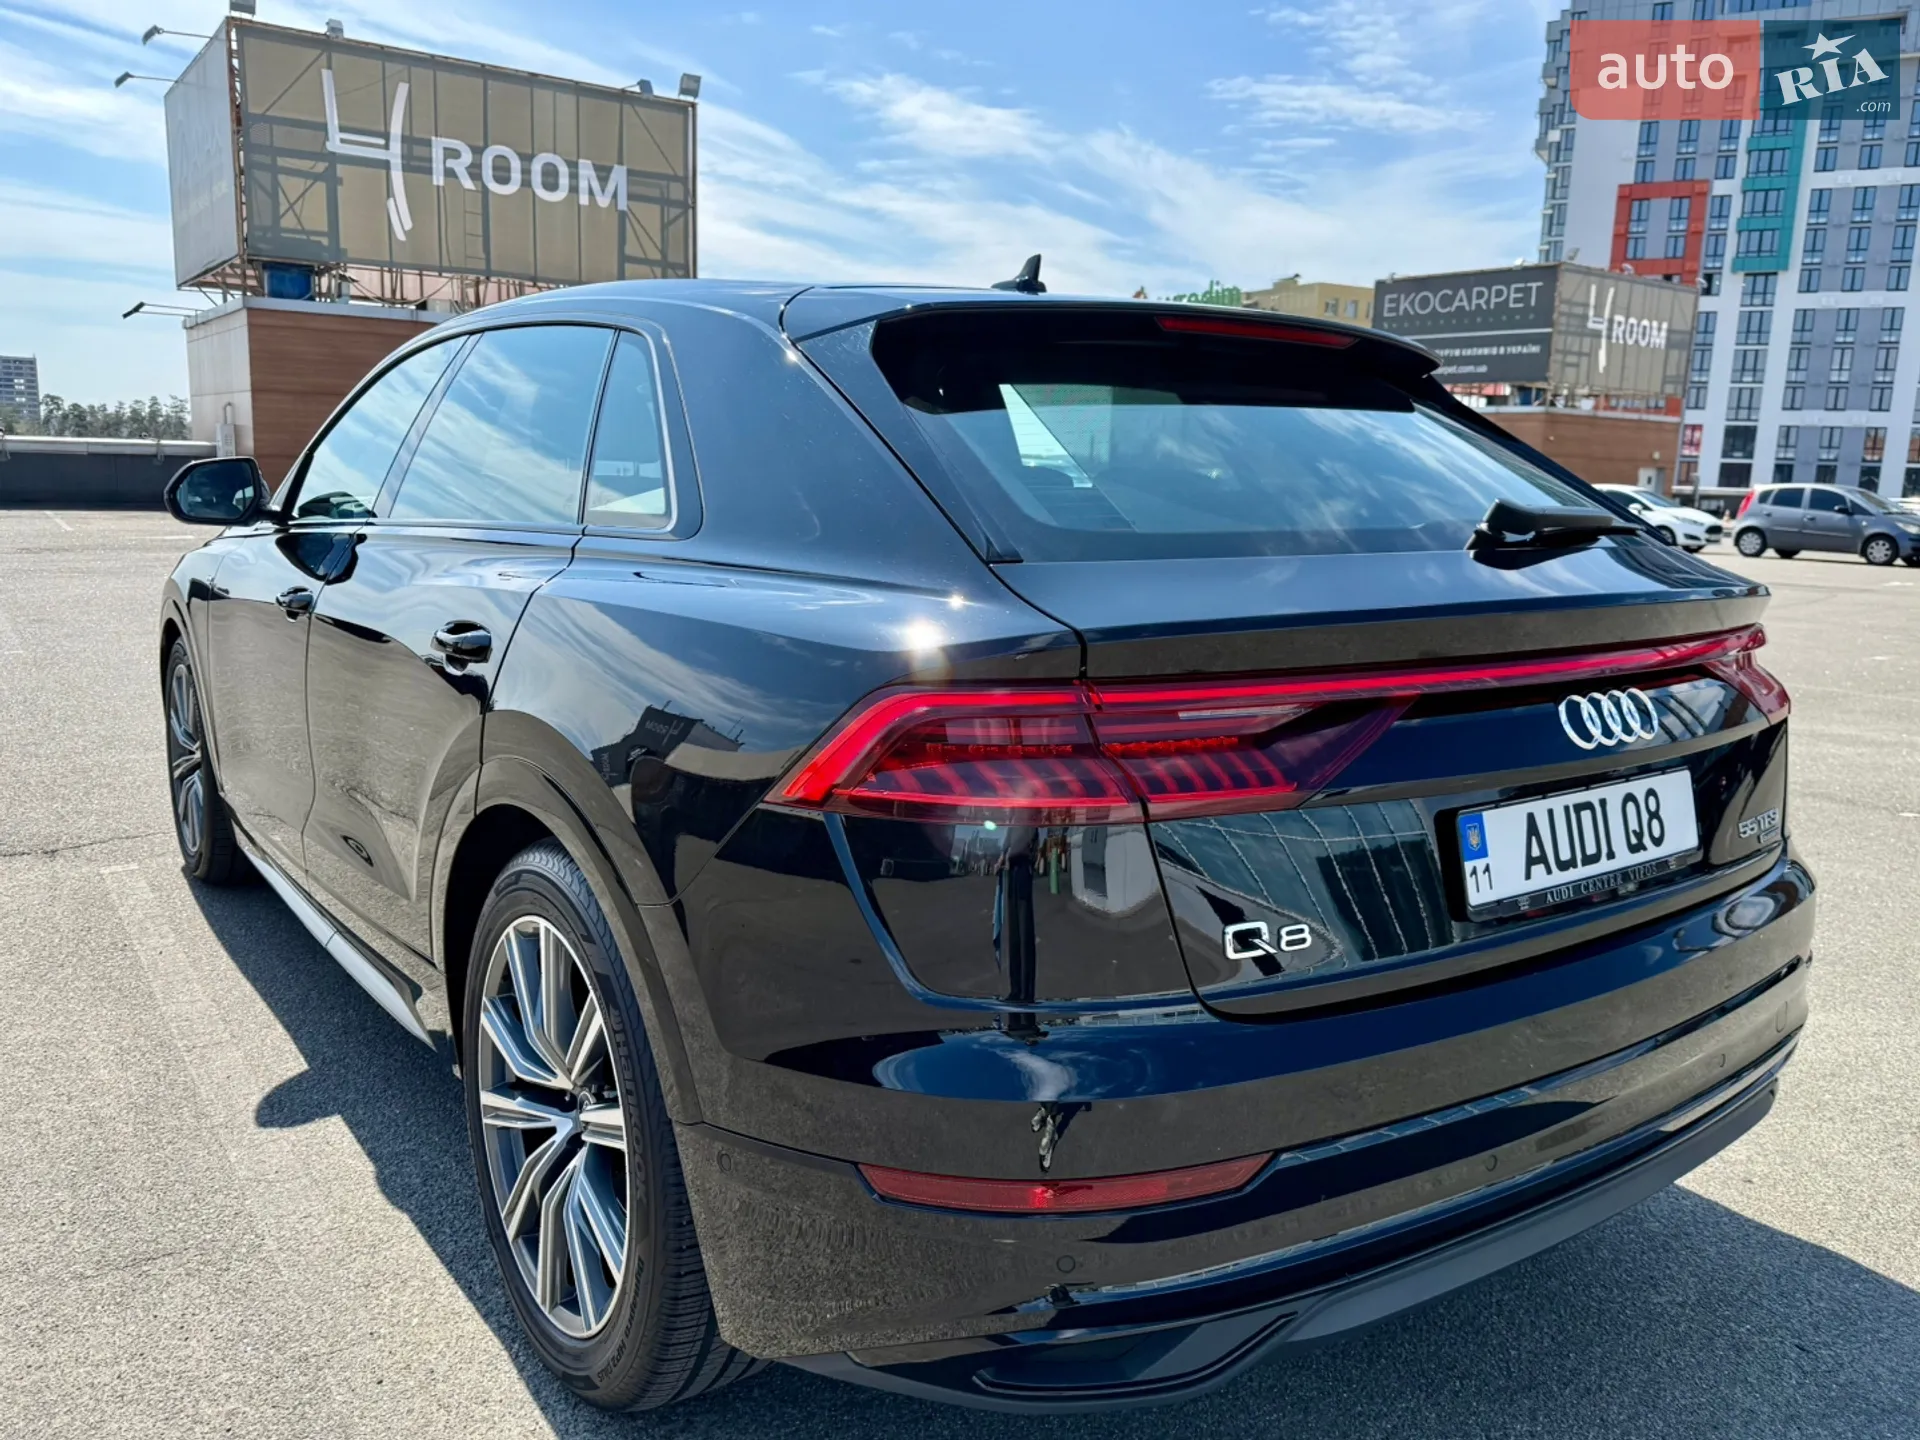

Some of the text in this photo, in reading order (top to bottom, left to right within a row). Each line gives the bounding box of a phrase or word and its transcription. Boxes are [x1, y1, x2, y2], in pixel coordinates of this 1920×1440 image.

[431, 136, 628, 211] ROOM
[1383, 281, 1544, 317] EKOCARPET
[1612, 314, 1668, 349] ROOM
[1525, 788, 1665, 881] AUDI Q8
[1739, 817, 1758, 838] 55
[1469, 862, 1493, 893] 11
[1546, 889, 1574, 904] AUDI
[1581, 872, 1623, 894] CENTER
[1224, 921, 1312, 959] Q8
